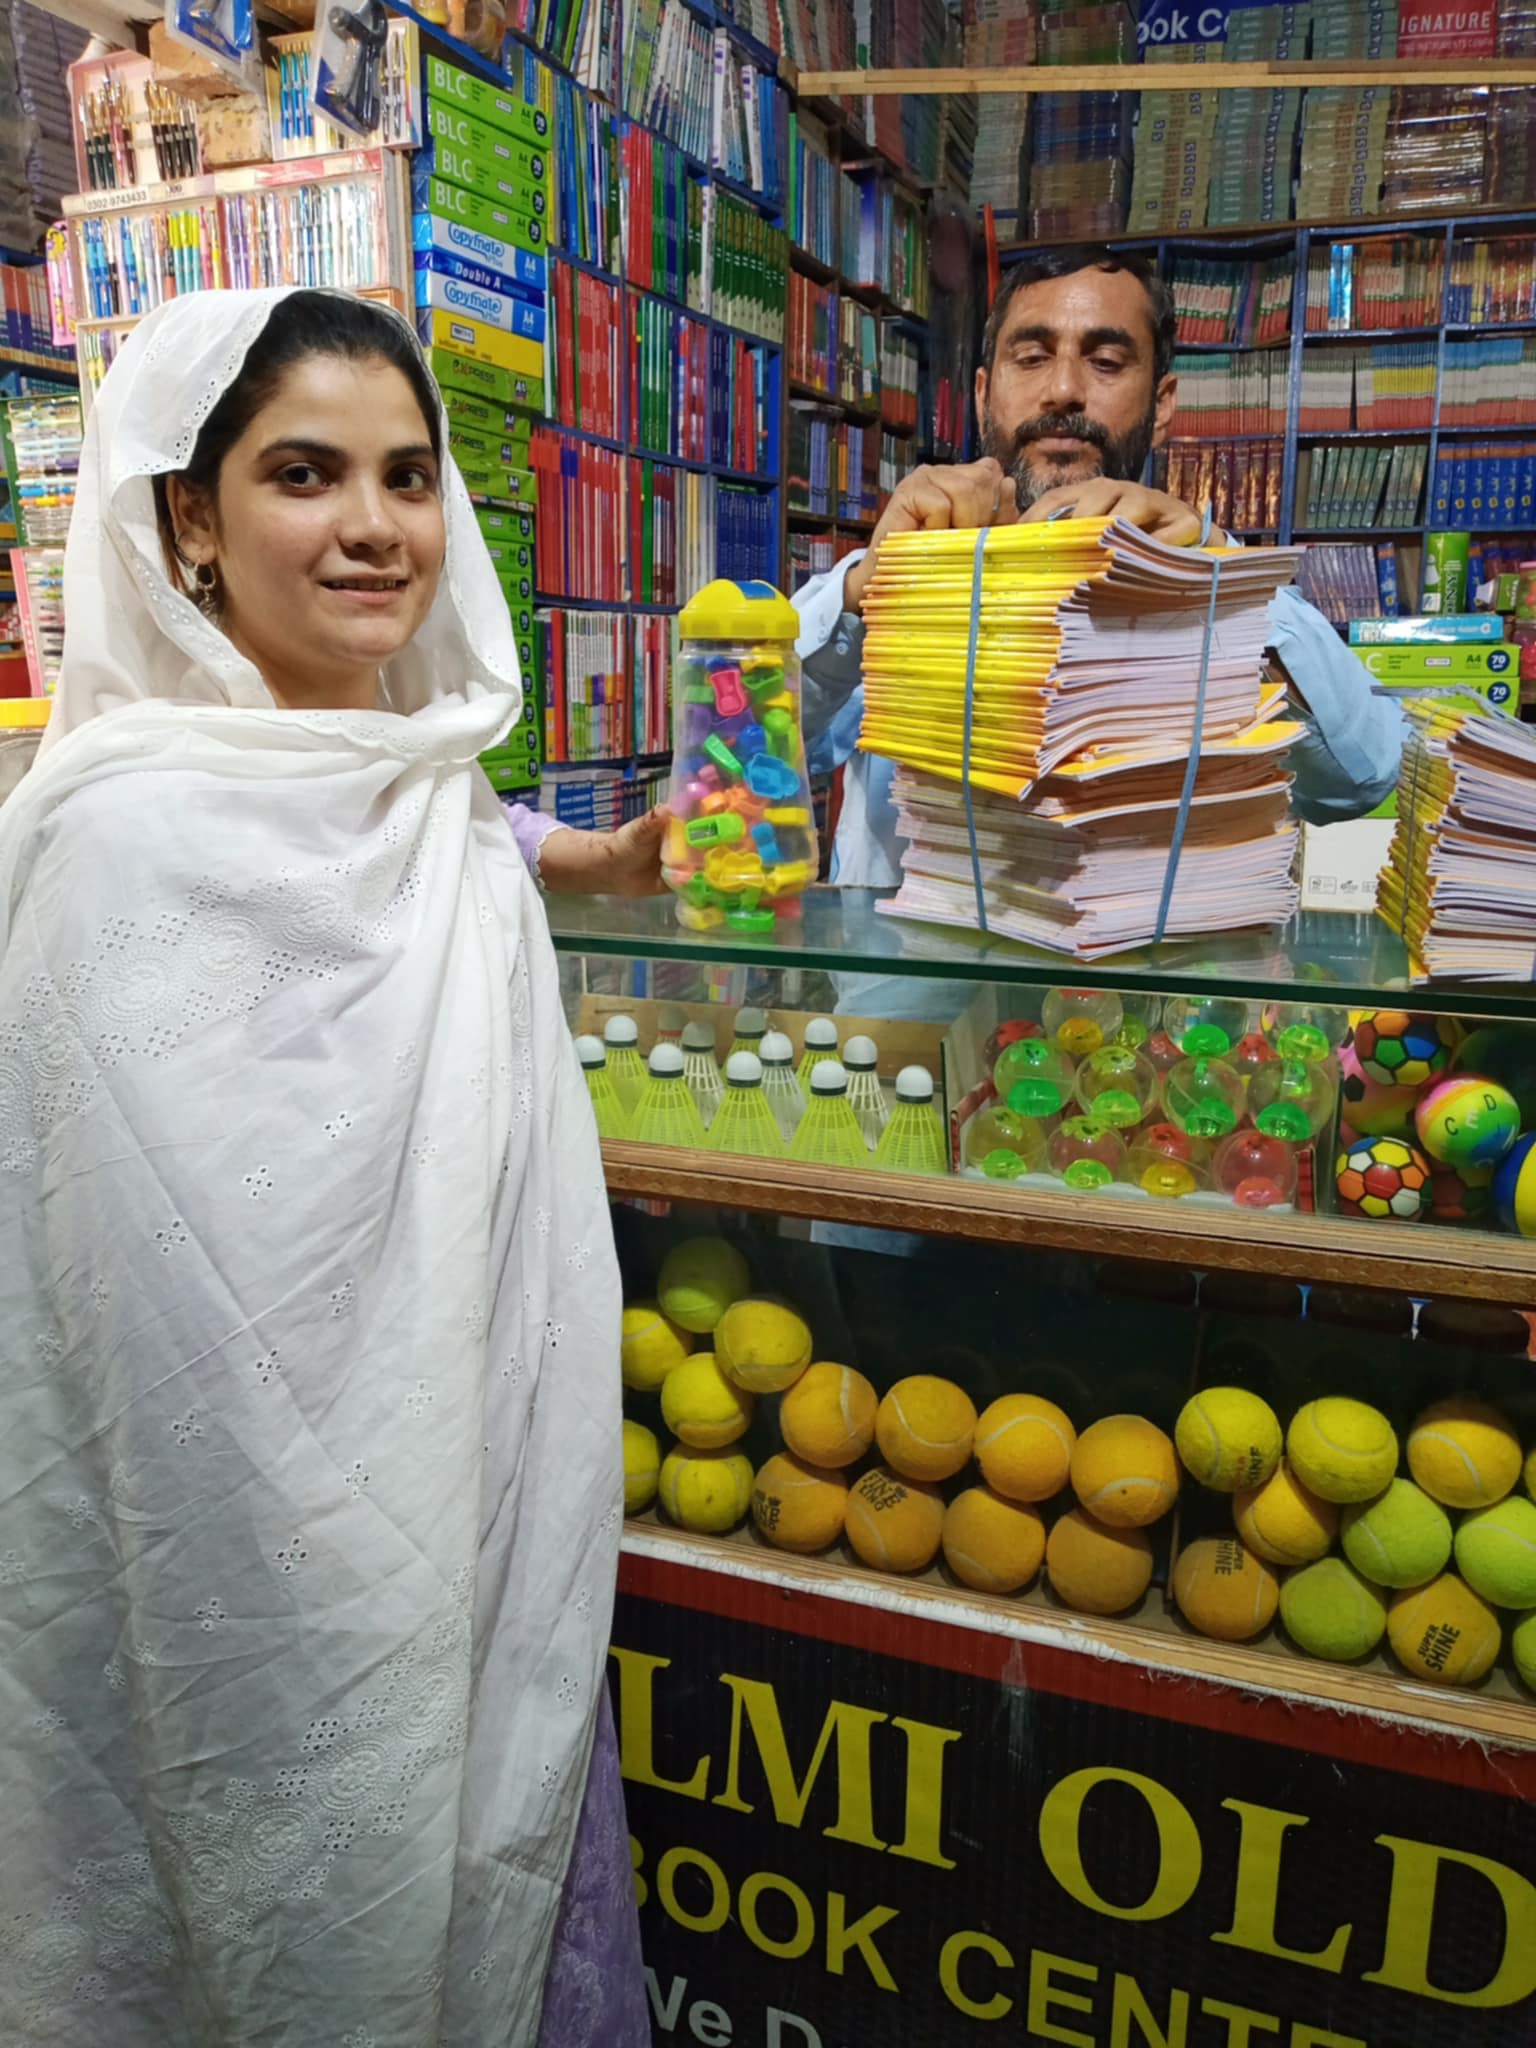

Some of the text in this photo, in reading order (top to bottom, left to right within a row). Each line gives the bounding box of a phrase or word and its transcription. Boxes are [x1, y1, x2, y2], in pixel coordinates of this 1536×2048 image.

[1198, 8, 1229, 37] C
[434, 63, 468, 99] BLC
[436, 111, 468, 146] BLC
[442, 150, 473, 183] BLC
[435, 181, 467, 215] BLC
[454, 262, 502, 289] Double A
[524, 256, 537, 272] A4
[523, 310, 535, 325] A4
[1466, 654, 1481, 664] A4
[1491, 655, 1507, 664] 70
[1492, 687, 1507, 696] 70
[1215, 1540, 1233, 1576] HINE
[1416, 1623, 1439, 1658] SUPER
[1425, 1623, 1462, 1673] SHINE
[607, 1644, 1536, 2010] LMI OLD
